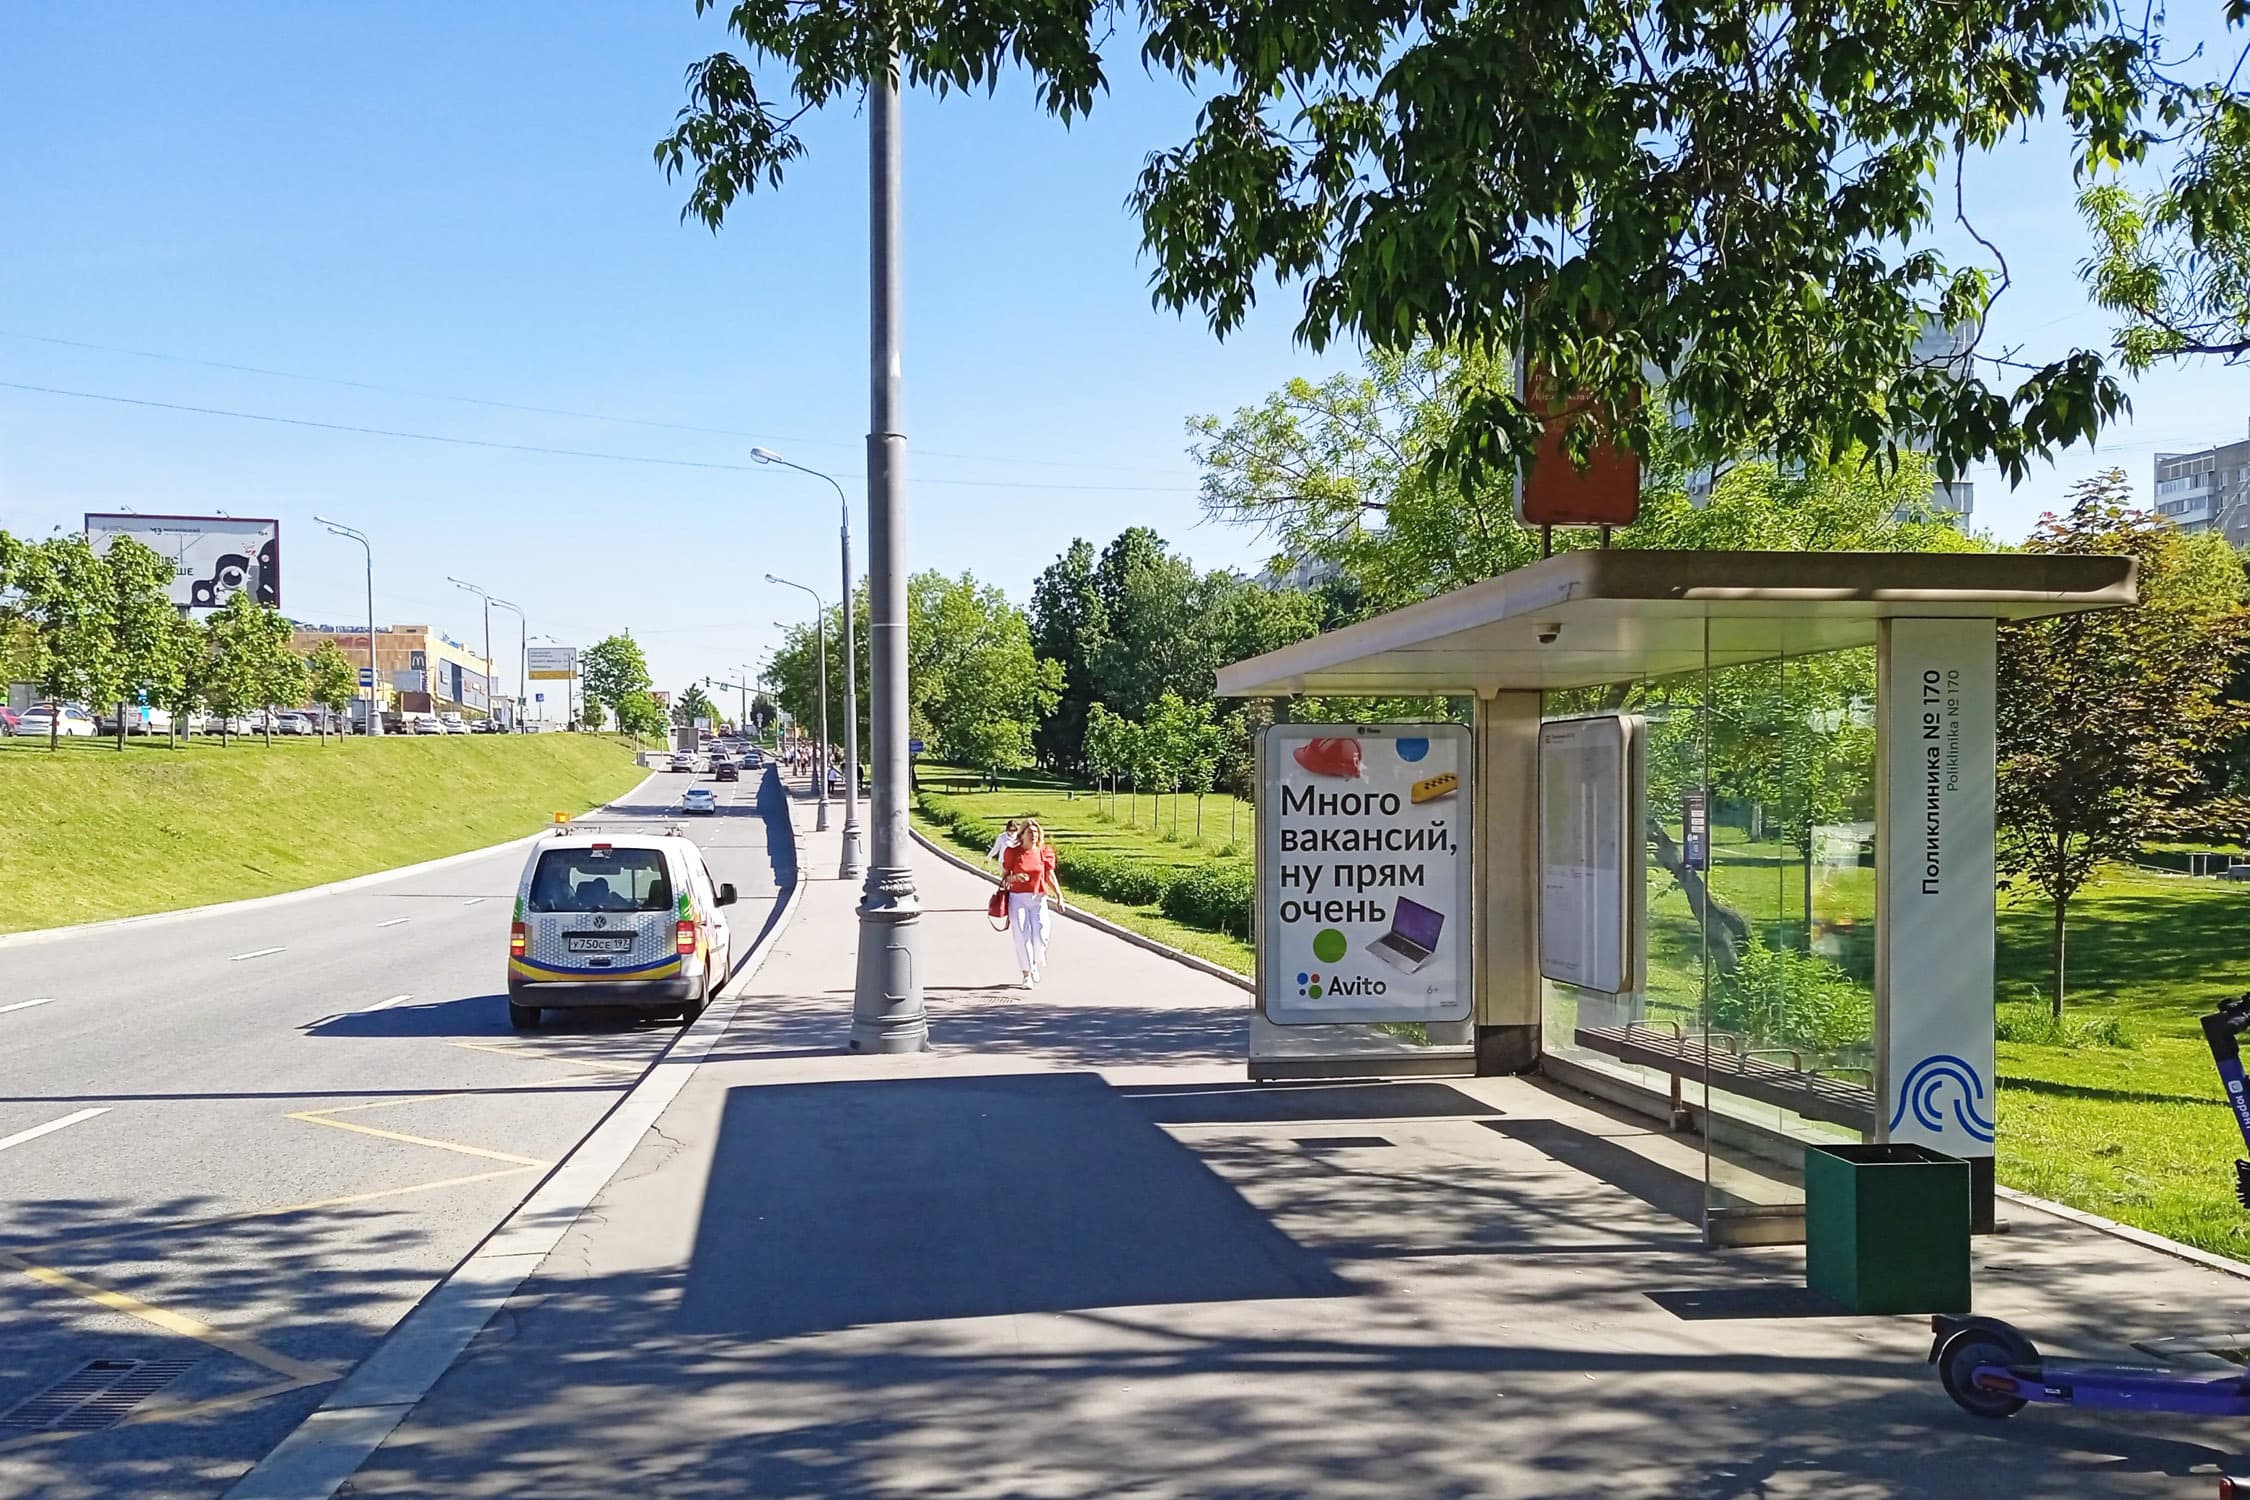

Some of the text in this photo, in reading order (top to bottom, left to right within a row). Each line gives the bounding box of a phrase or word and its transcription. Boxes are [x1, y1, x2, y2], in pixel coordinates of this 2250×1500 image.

[1947, 669, 1959, 792] Poliklinika № 170
[1922, 669, 1940, 894] Поликлиника № 170
[1281, 784, 1401, 816] Много
[1280, 820, 1458, 855] вакансий,
[1280, 864, 1425, 893] ну прям
[1280, 900, 1386, 923] очень
[1327, 975, 1387, 996] Avito
